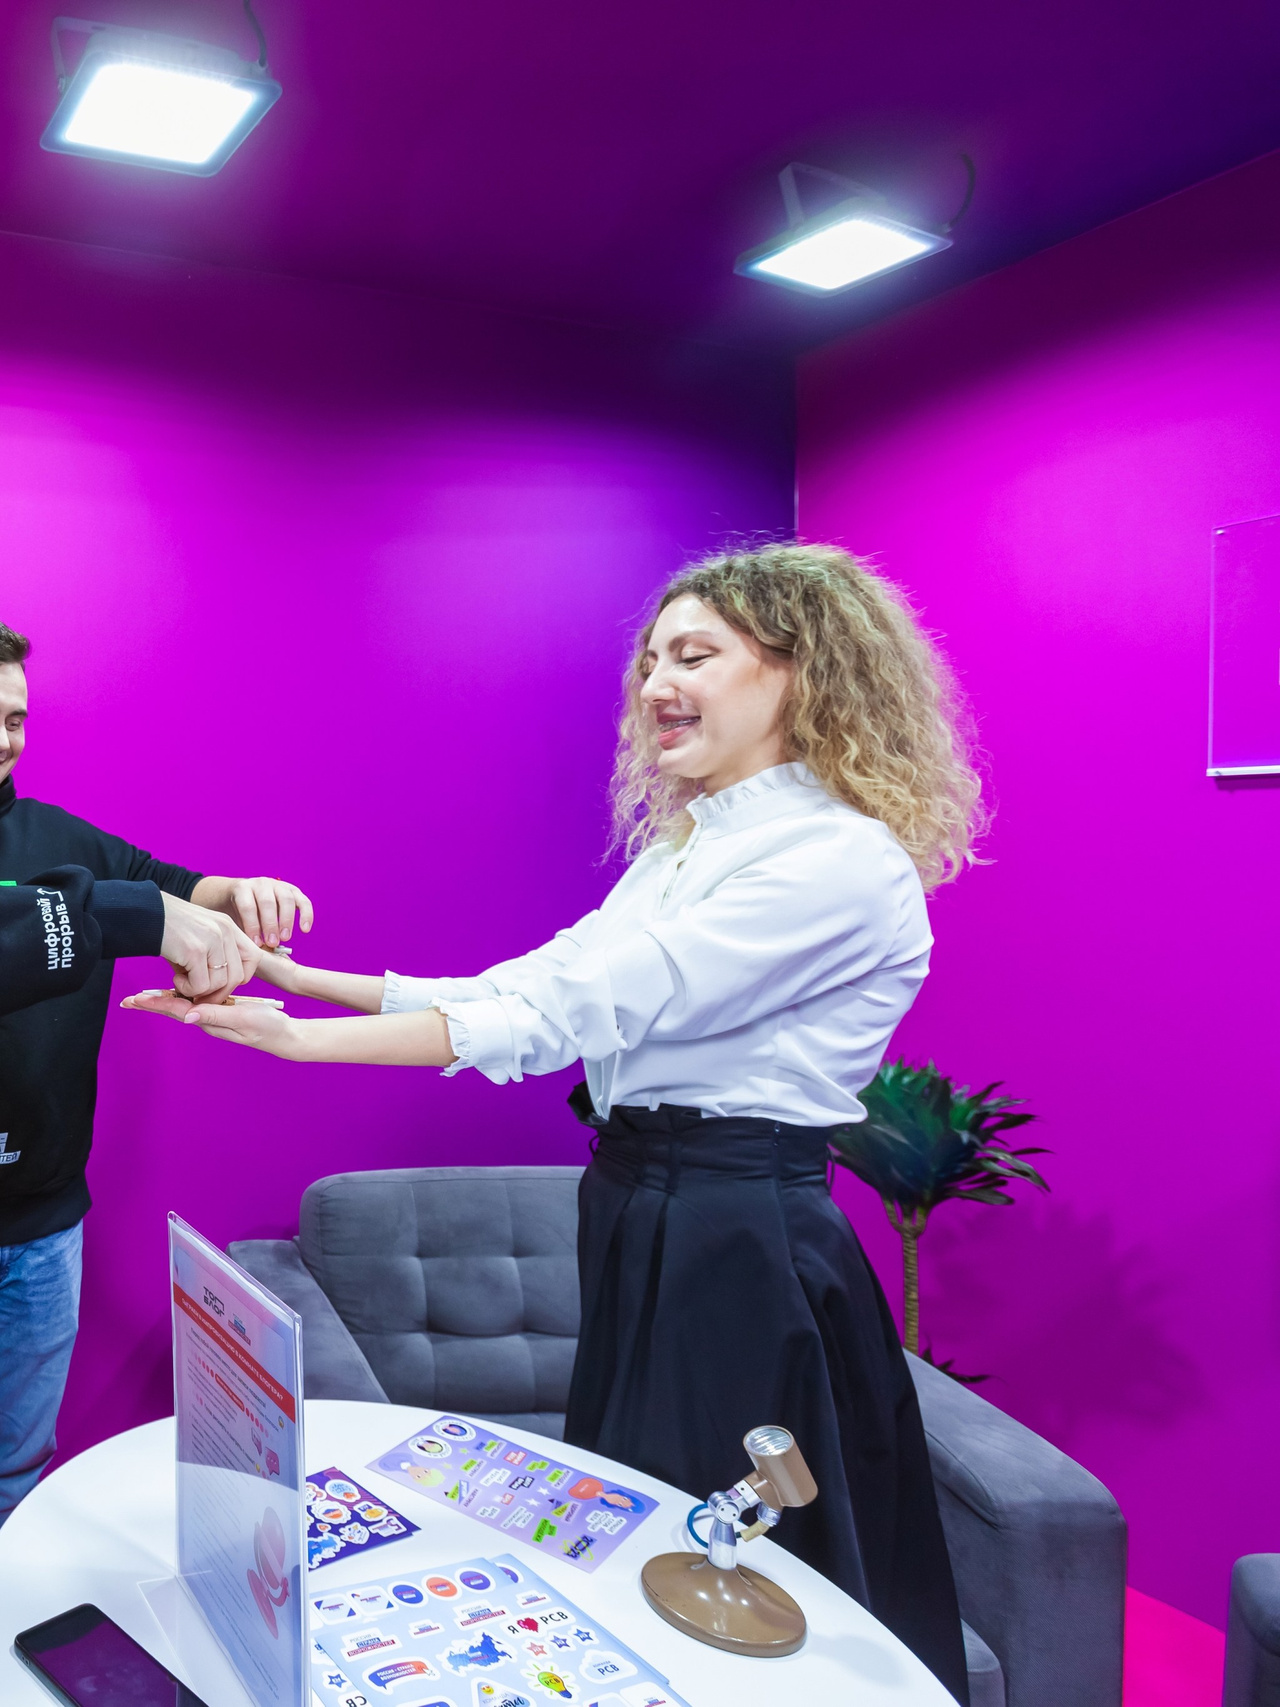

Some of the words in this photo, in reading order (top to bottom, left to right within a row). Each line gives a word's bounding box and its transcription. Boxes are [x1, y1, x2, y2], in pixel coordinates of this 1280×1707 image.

[55, 903, 75, 969] прорыв
[203, 1295, 225, 1317] БЛОГ
[507, 1625, 519, 1634] Я
[539, 1611, 568, 1625] РСВ
[597, 1664, 620, 1676] РСВ
[544, 1678, 561, 1686] РСВ
